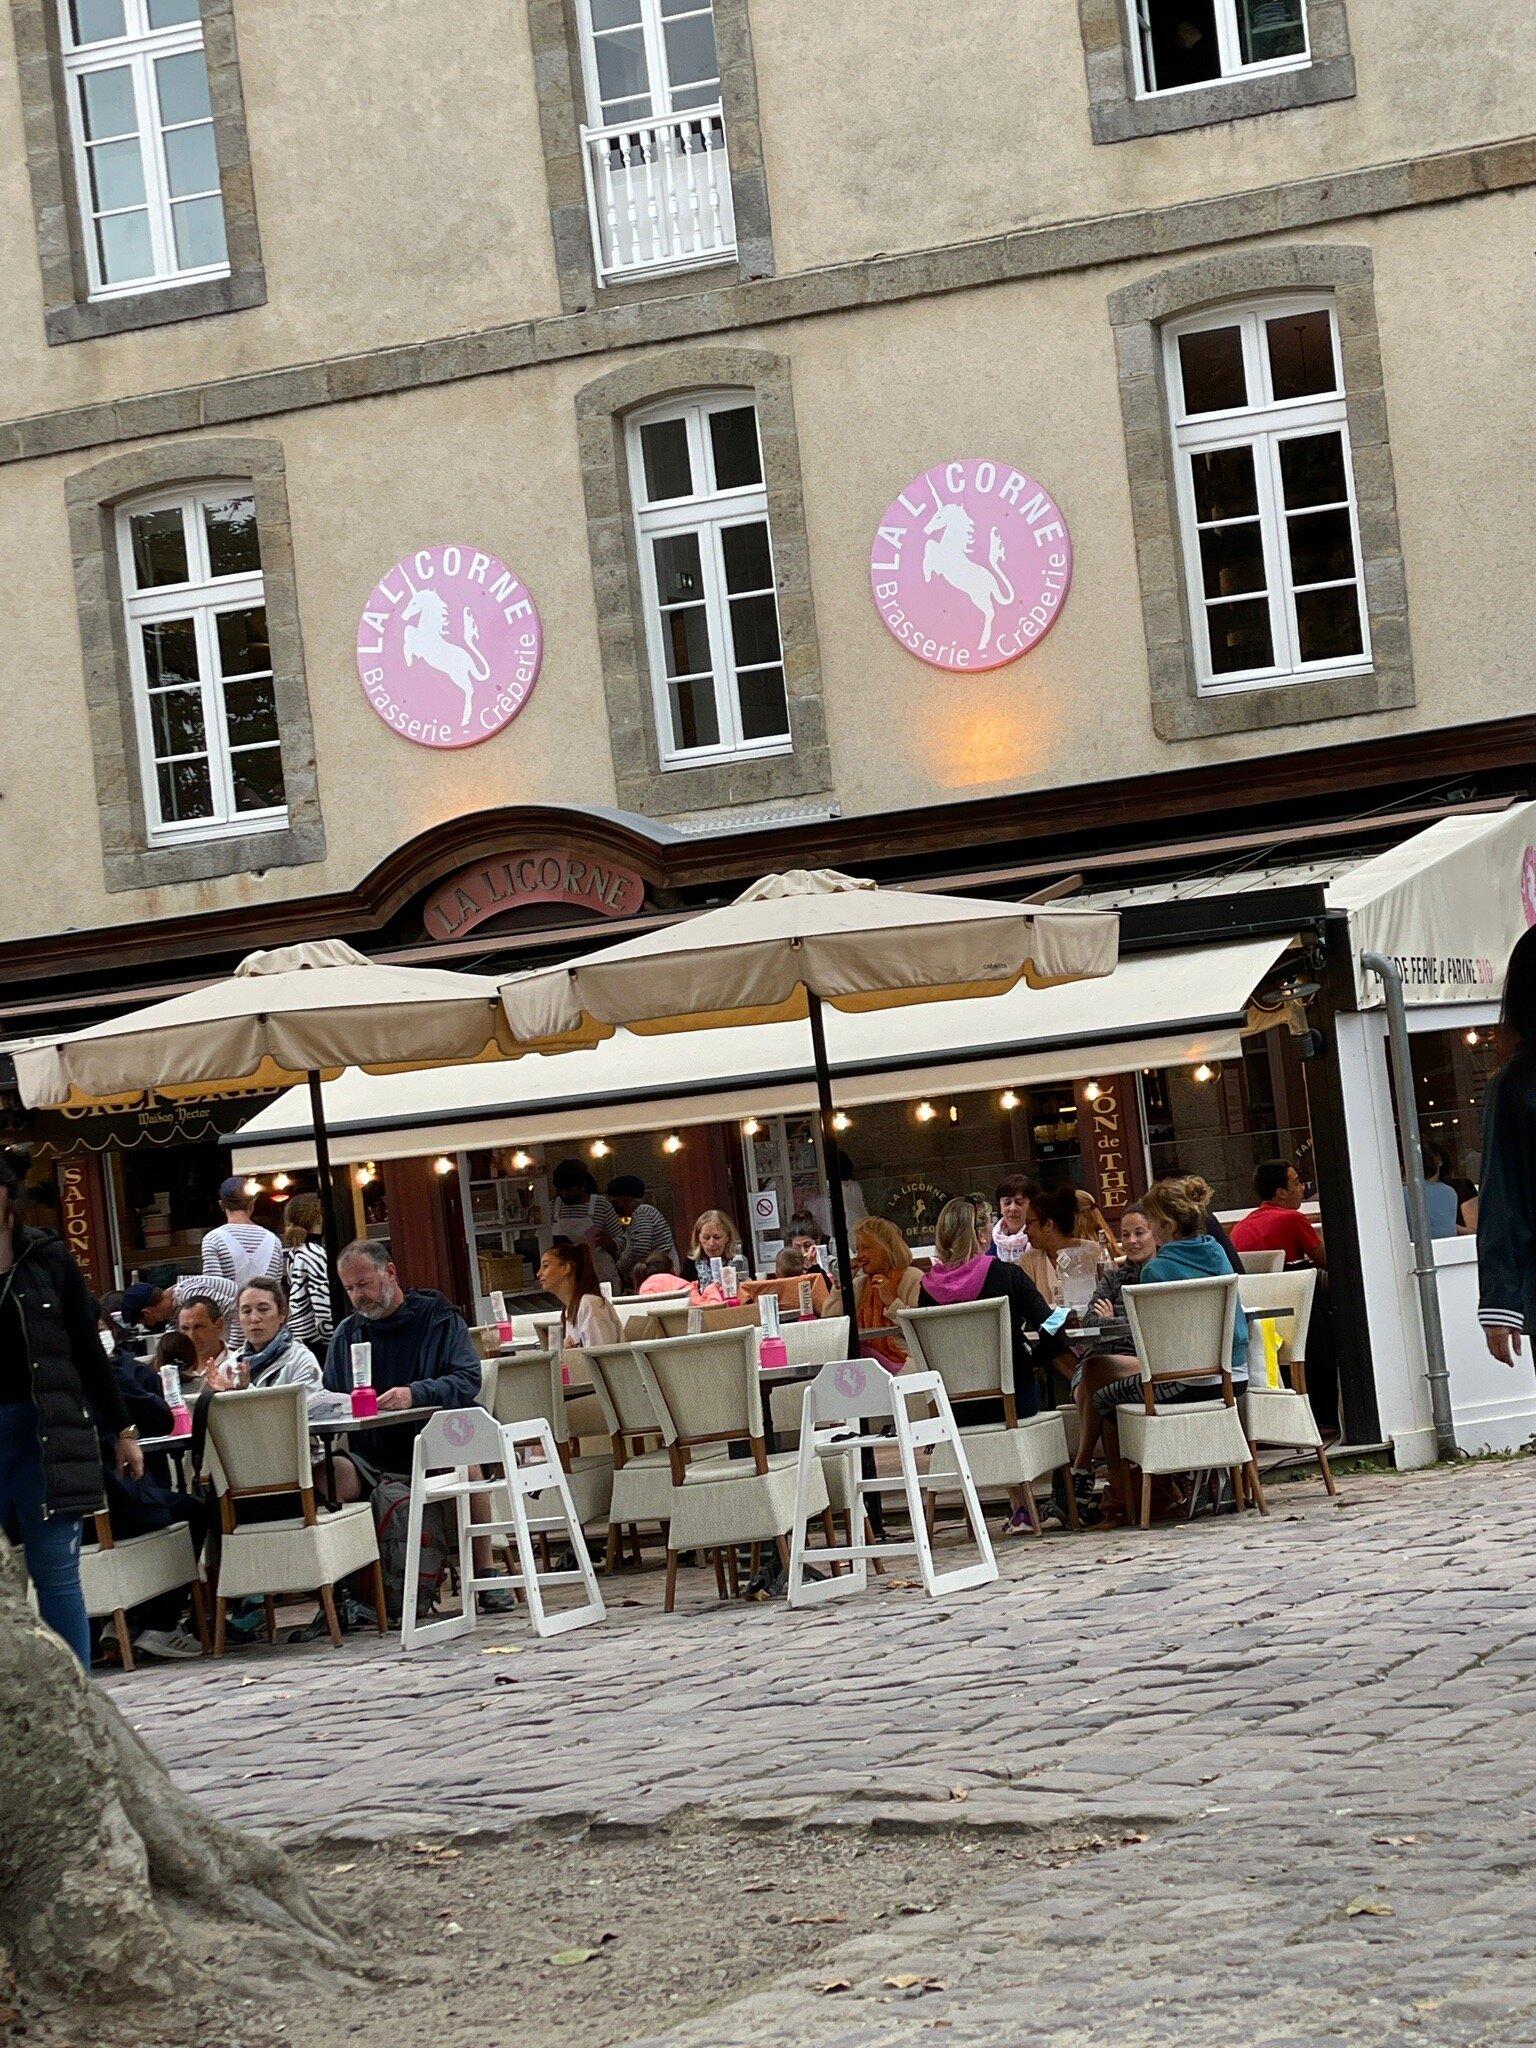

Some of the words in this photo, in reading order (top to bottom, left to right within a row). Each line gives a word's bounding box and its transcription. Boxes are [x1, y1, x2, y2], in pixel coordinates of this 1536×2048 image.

[871, 526, 908, 571] LA
[357, 610, 390, 654] LA
[877, 581, 970, 667] Brasserie
[996, 553, 1066, 657] Crêperie
[363, 667, 452, 742] Brasserie
[479, 633, 536, 730] Crêperie
[434, 887, 482, 934] LA
[481, 857, 634, 912] LICORNE
[1440, 961, 1446, 984] &
[1447, 957, 1477, 984] FARINE
[1098, 1135, 1120, 1148] de
[64, 1168, 90, 1253] SALON
[888, 1193, 901, 1207] LA
[901, 1183, 947, 1202] LICORNE
[906, 1227, 919, 1236] DE
[922, 1225, 937, 1234] CO
